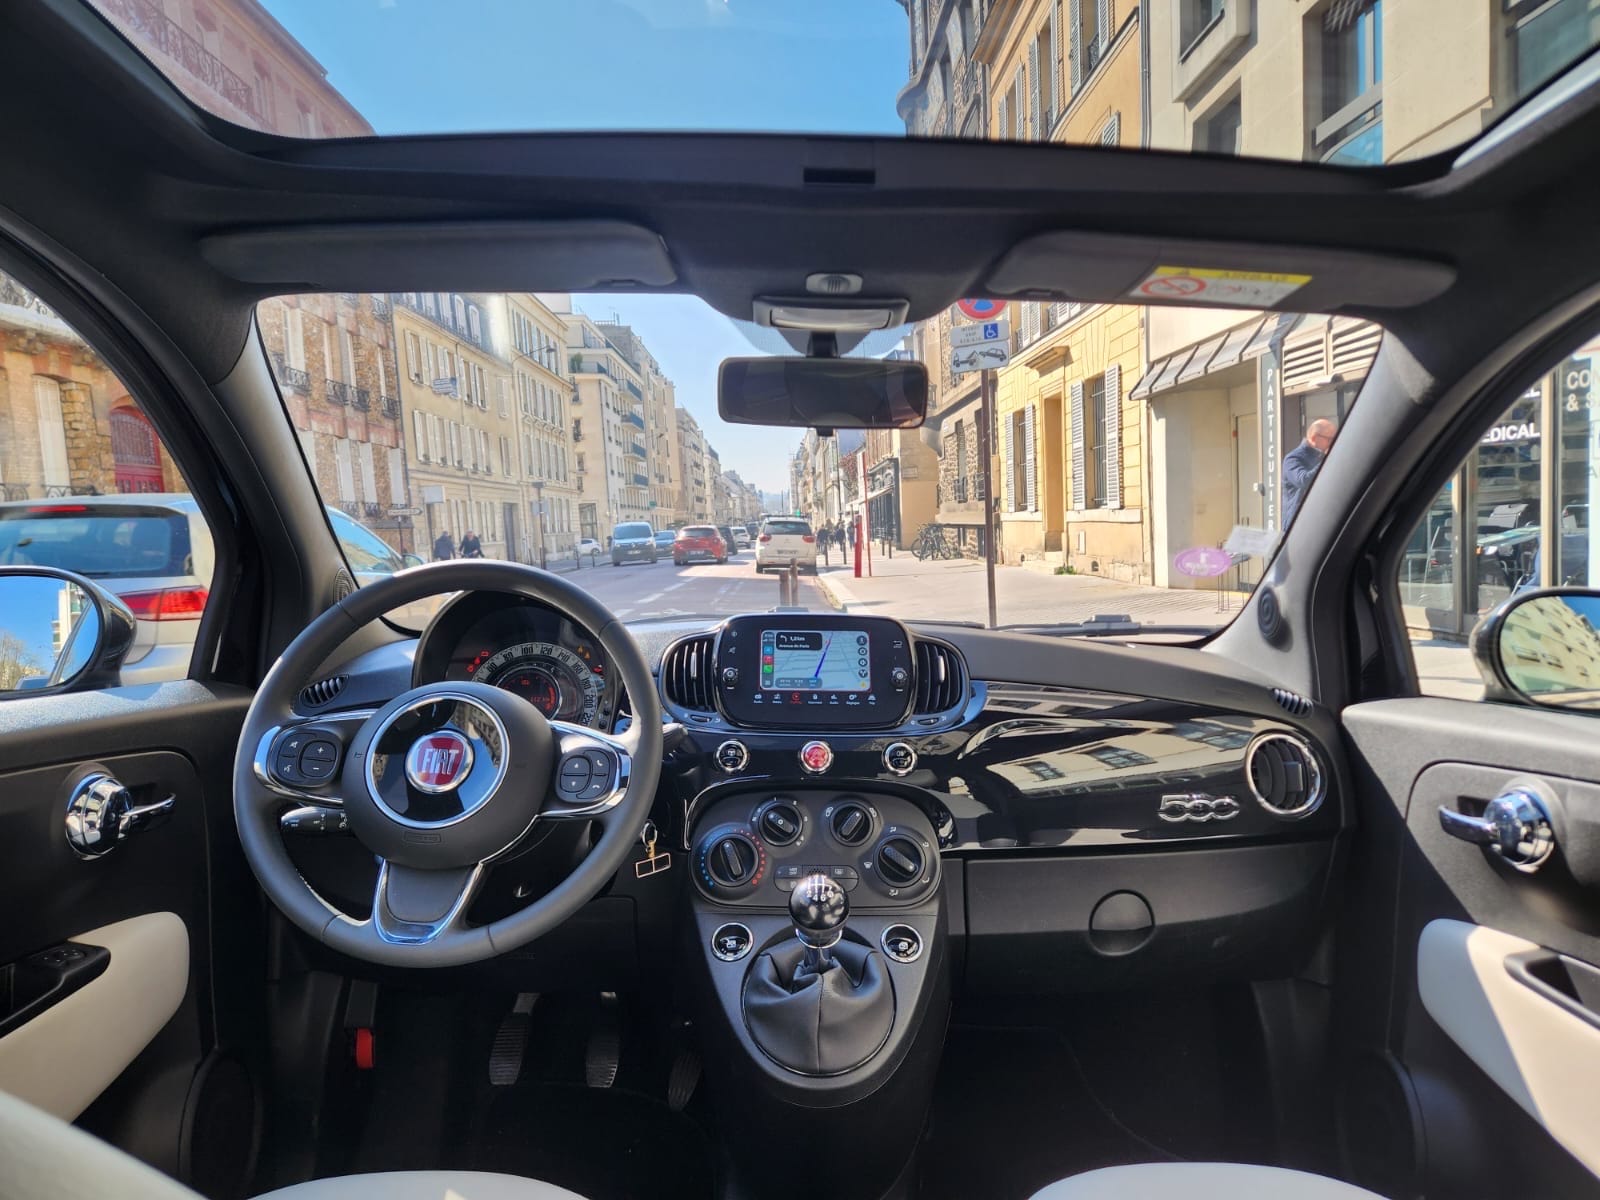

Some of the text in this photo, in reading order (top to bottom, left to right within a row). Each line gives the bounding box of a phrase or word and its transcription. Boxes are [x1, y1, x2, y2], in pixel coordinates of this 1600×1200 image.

[1267, 368, 1275, 532] PARTICULIER
[421, 748, 460, 775] FIAT
[1158, 793, 1239, 822] 500
